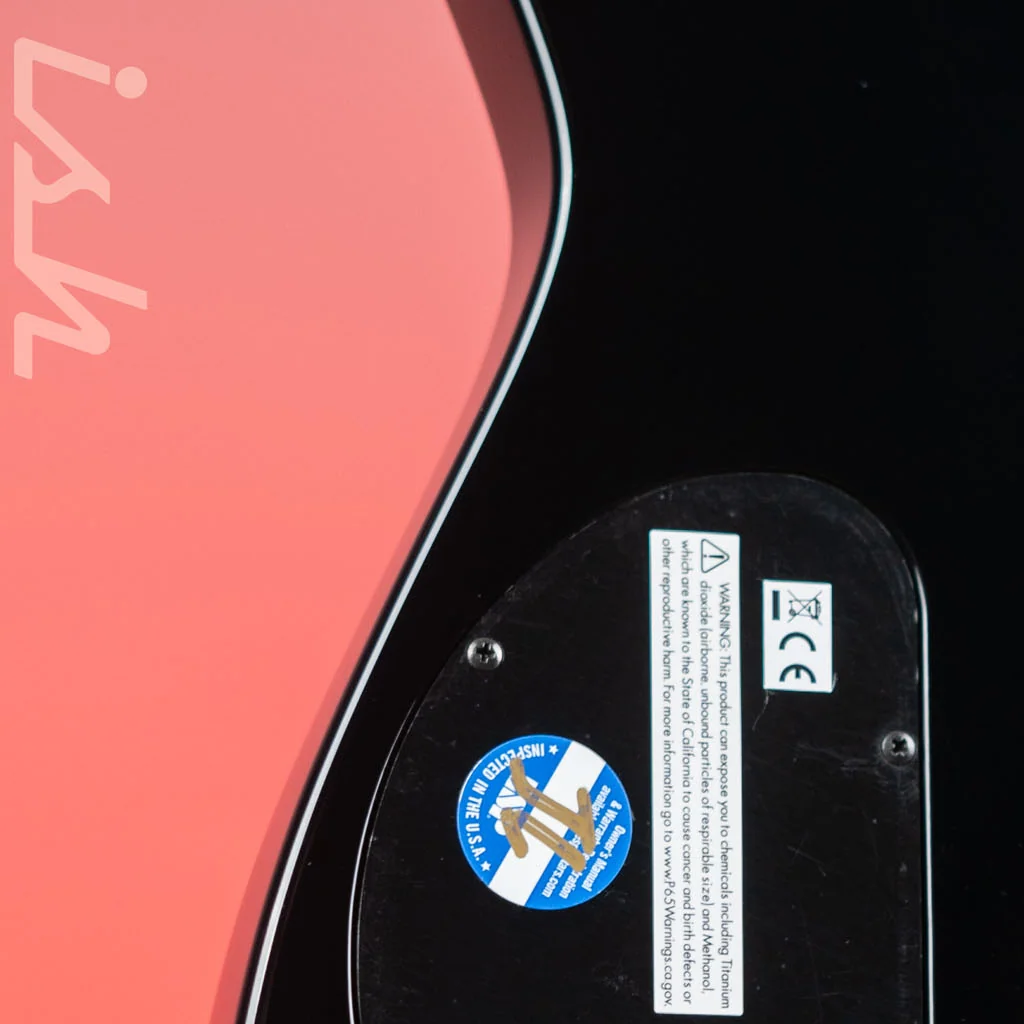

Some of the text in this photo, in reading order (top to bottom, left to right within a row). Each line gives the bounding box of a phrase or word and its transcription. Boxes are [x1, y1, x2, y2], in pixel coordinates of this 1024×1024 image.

[662, 538, 674, 569] other
[659, 572, 675, 647] reproductive
[700, 580, 712, 625] dioxide
[779, 632, 816, 684] CE
[663, 685, 675, 704] For
[701, 688, 713, 739] unbound
[663, 706, 671, 737] more
[663, 740, 675, 808] information
[681, 540, 695, 1004] which are known to the State of California to cause cancer and birth defects or
[697, 741, 713, 793] particles
[465, 743, 545, 862] INSPECTED IN THE U.S.A.
[610, 800, 621, 809] &
[660, 811, 671, 827] go
[701, 797, 714, 810] of
[716, 582, 734, 1009] WARNING: This product can expose you to chemicals including Titanium
[581, 825, 625, 891] Owner's Manual
[664, 830, 673, 843] to
[698, 813, 714, 874] respirable
[700, 877, 714, 906] size)
[702, 908, 714, 931] and
[701, 934, 714, 994] Methanol,
